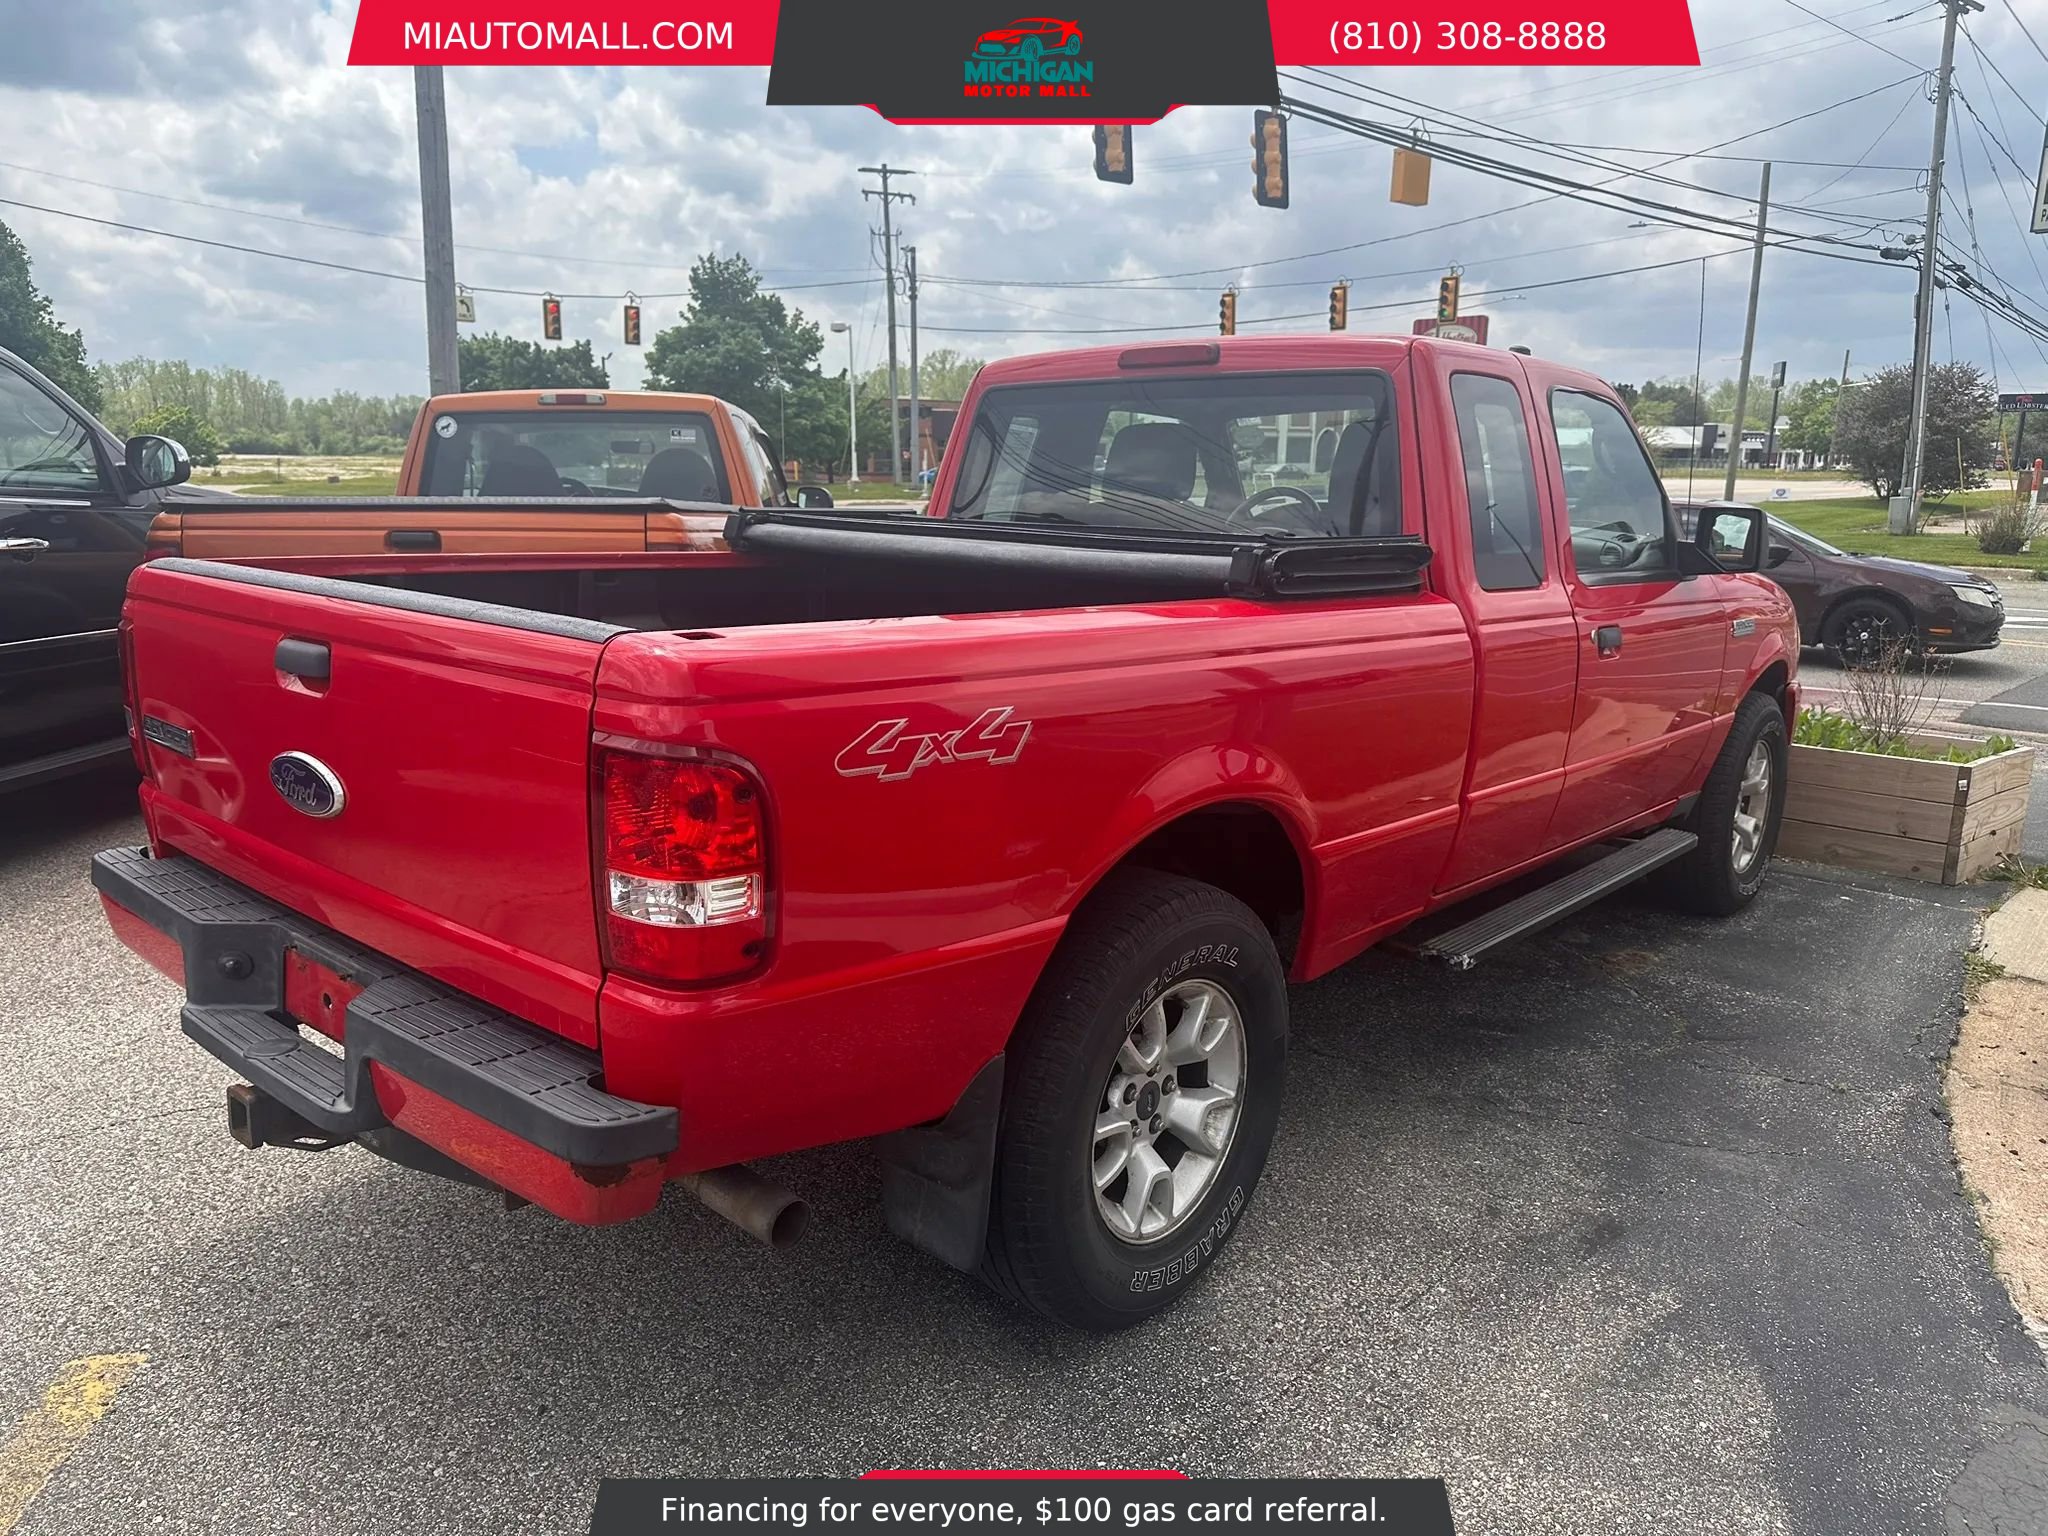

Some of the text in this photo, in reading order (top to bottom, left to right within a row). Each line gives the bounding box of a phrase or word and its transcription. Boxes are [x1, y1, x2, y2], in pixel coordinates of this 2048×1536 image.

[834, 705, 1034, 783] 4x4
[1125, 944, 1239, 1032] GENERAL
[1130, 1185, 1245, 1292] GRABBER
